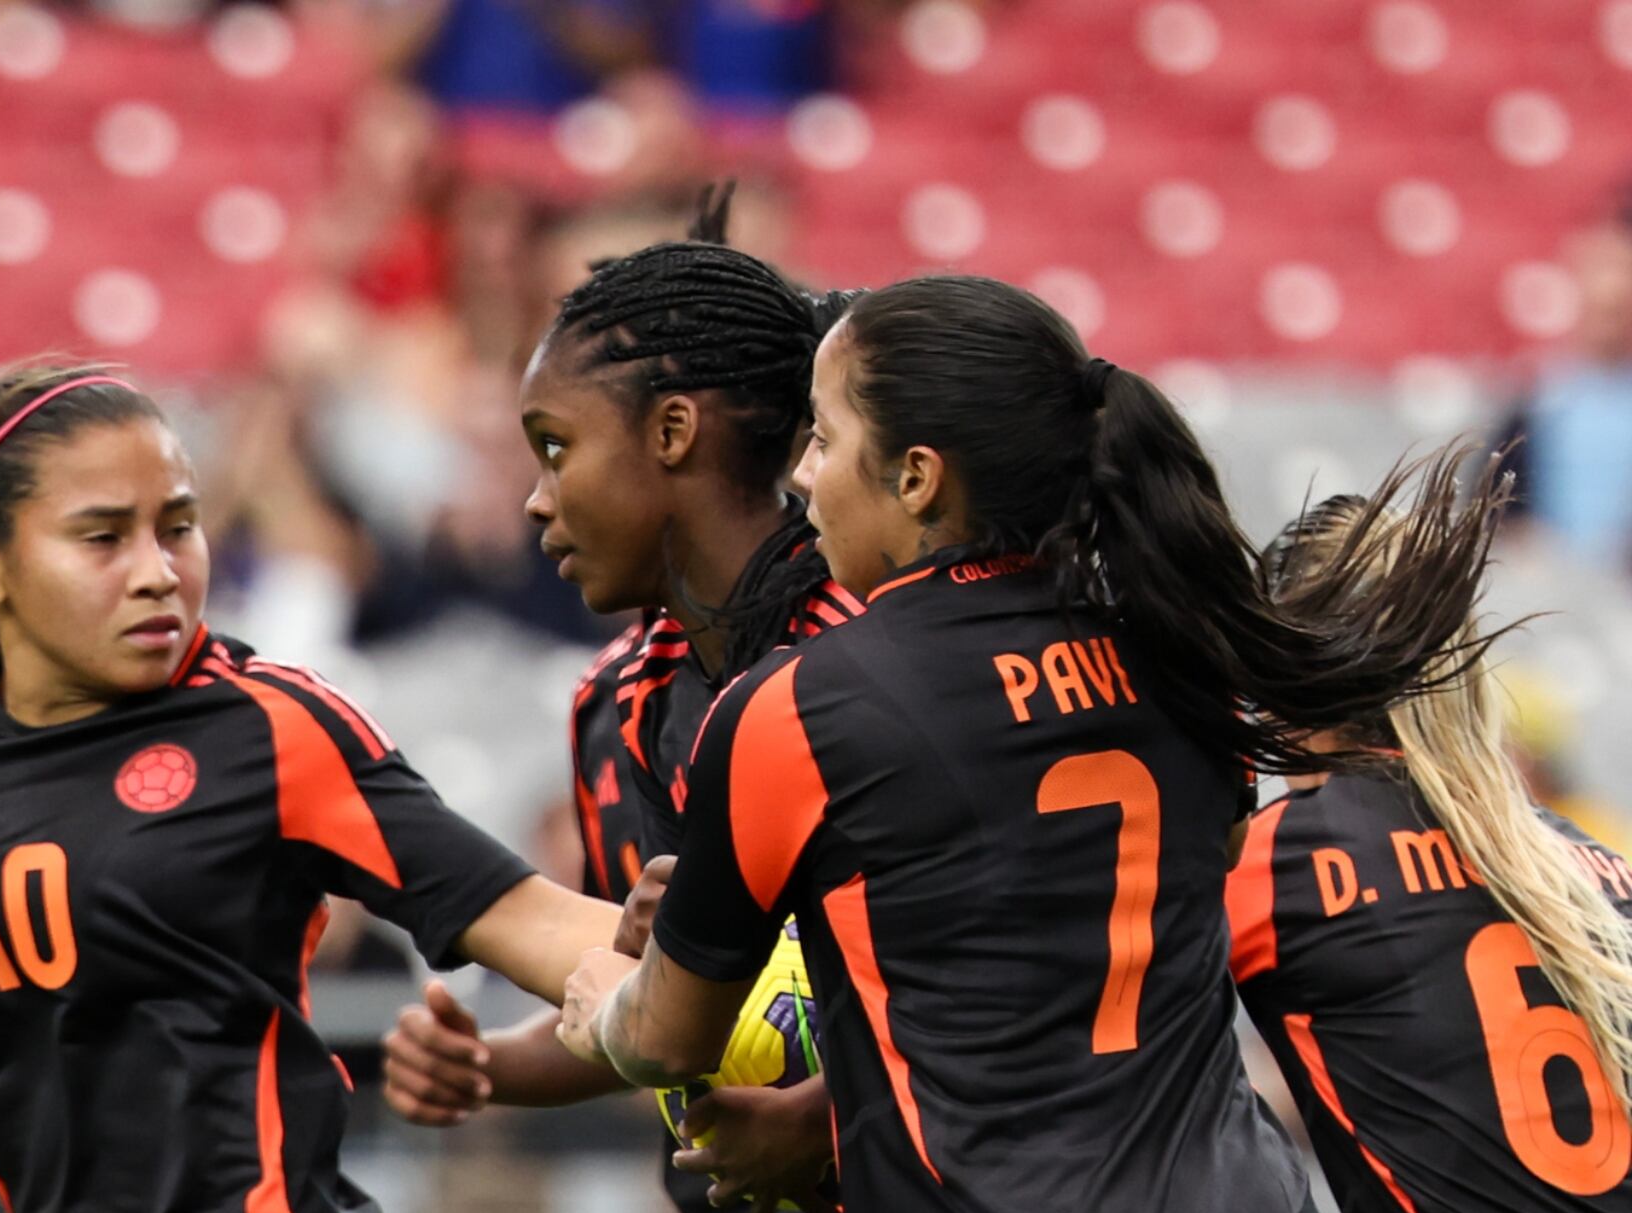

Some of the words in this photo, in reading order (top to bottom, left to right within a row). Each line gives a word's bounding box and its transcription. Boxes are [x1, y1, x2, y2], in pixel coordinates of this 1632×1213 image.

[1036, 751, 1160, 1055] 7
[1311, 847, 1379, 918] D.
[1464, 922, 1632, 1196] 6
